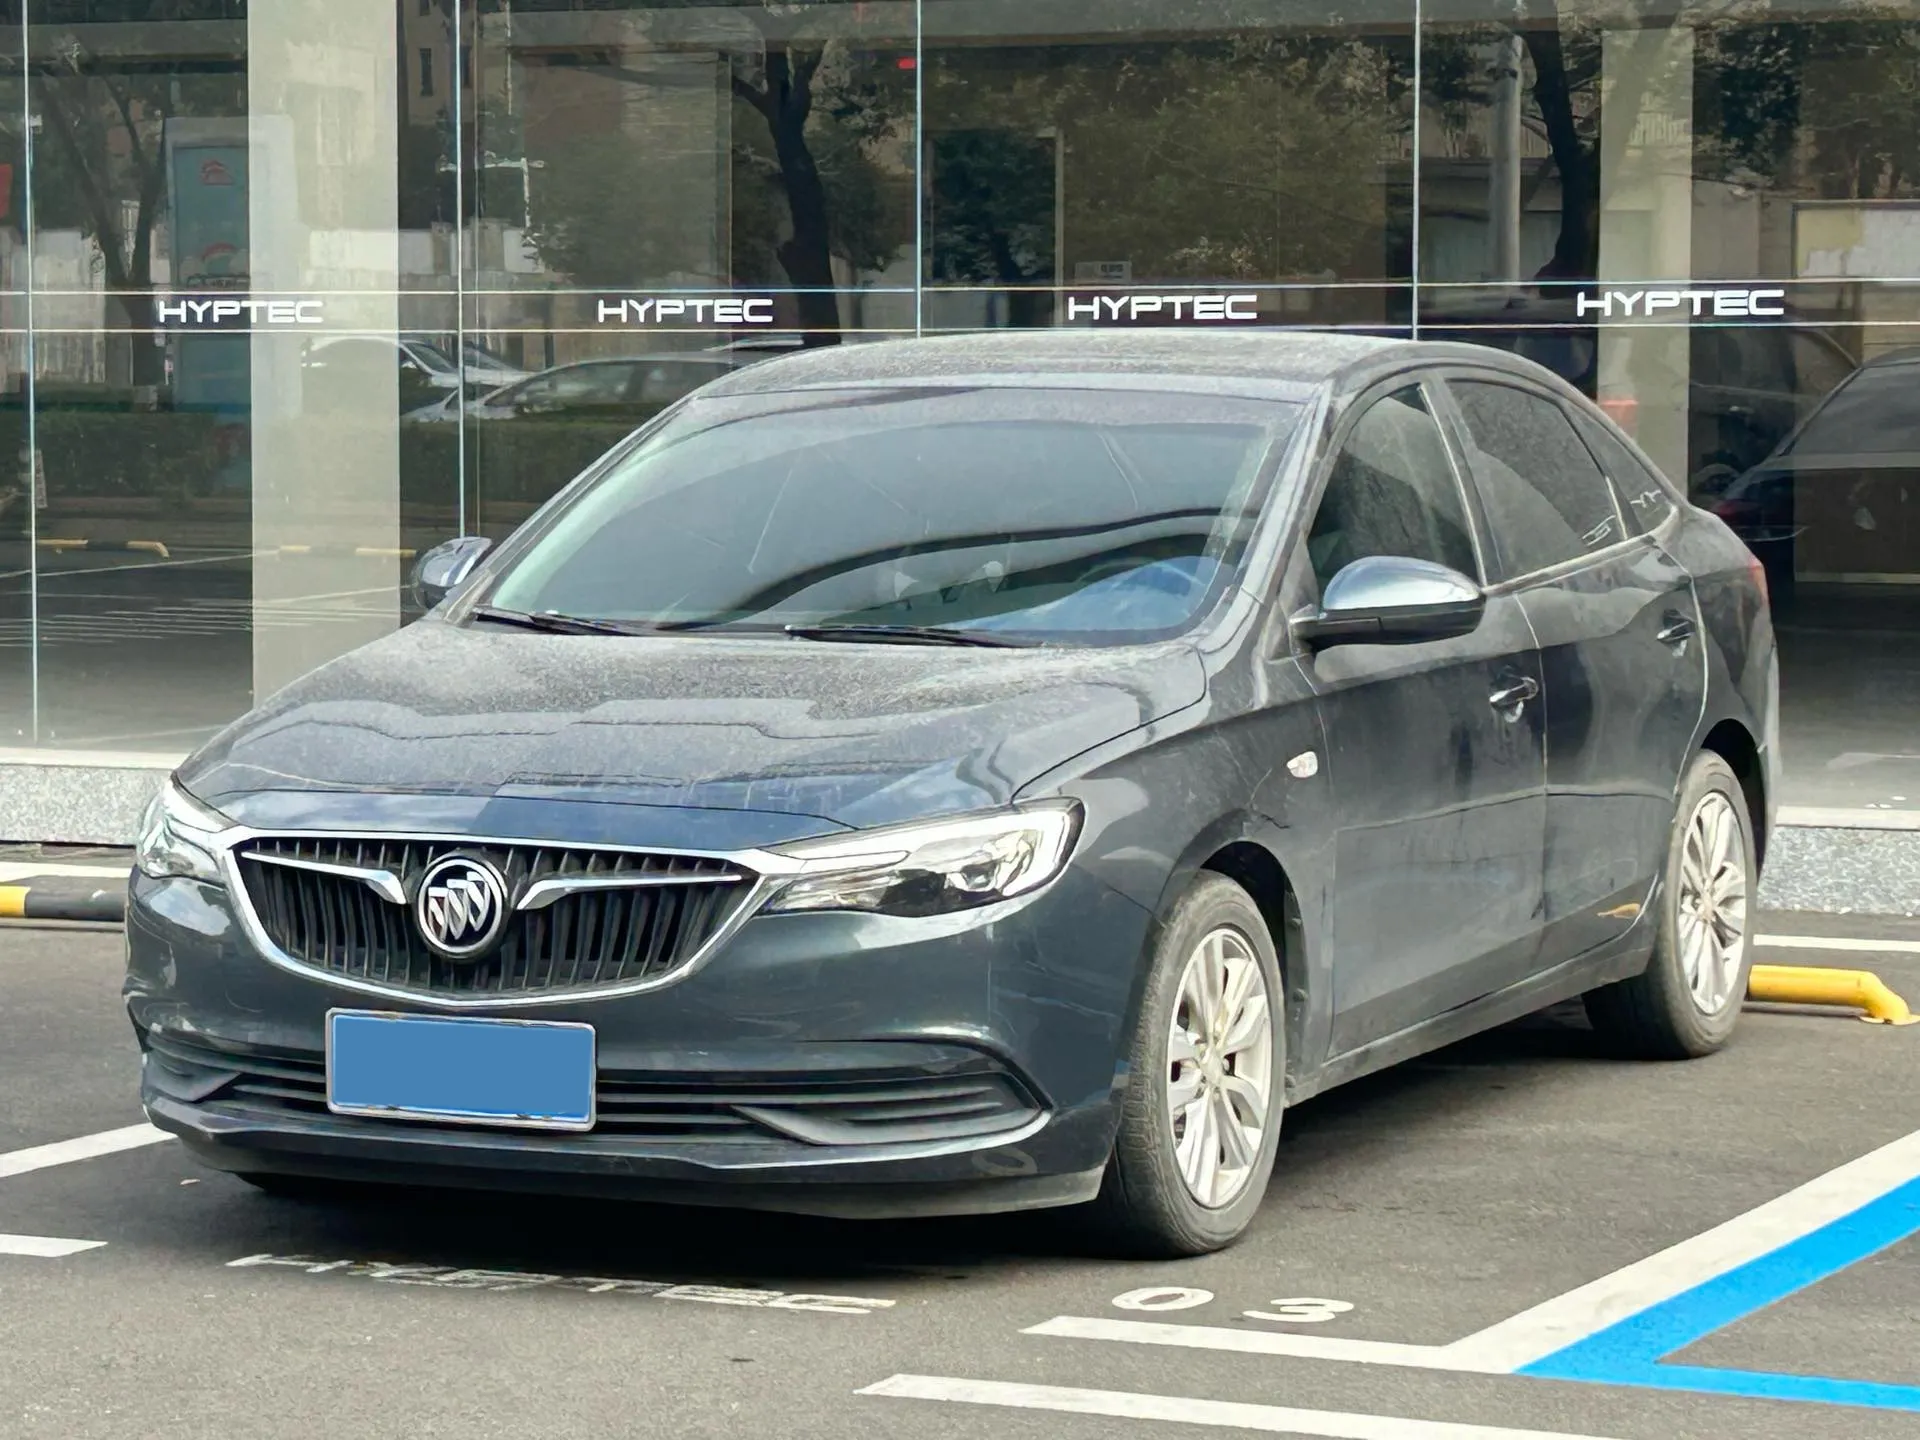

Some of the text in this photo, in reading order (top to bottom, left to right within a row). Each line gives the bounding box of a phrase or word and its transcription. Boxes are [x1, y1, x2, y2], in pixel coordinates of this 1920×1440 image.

[159, 300, 323, 323] HYPTEC
[597, 299, 773, 323] HYPTEC
[1068, 294, 1257, 321] HYPTEC
[1576, 289, 1784, 317] HYPTEC
